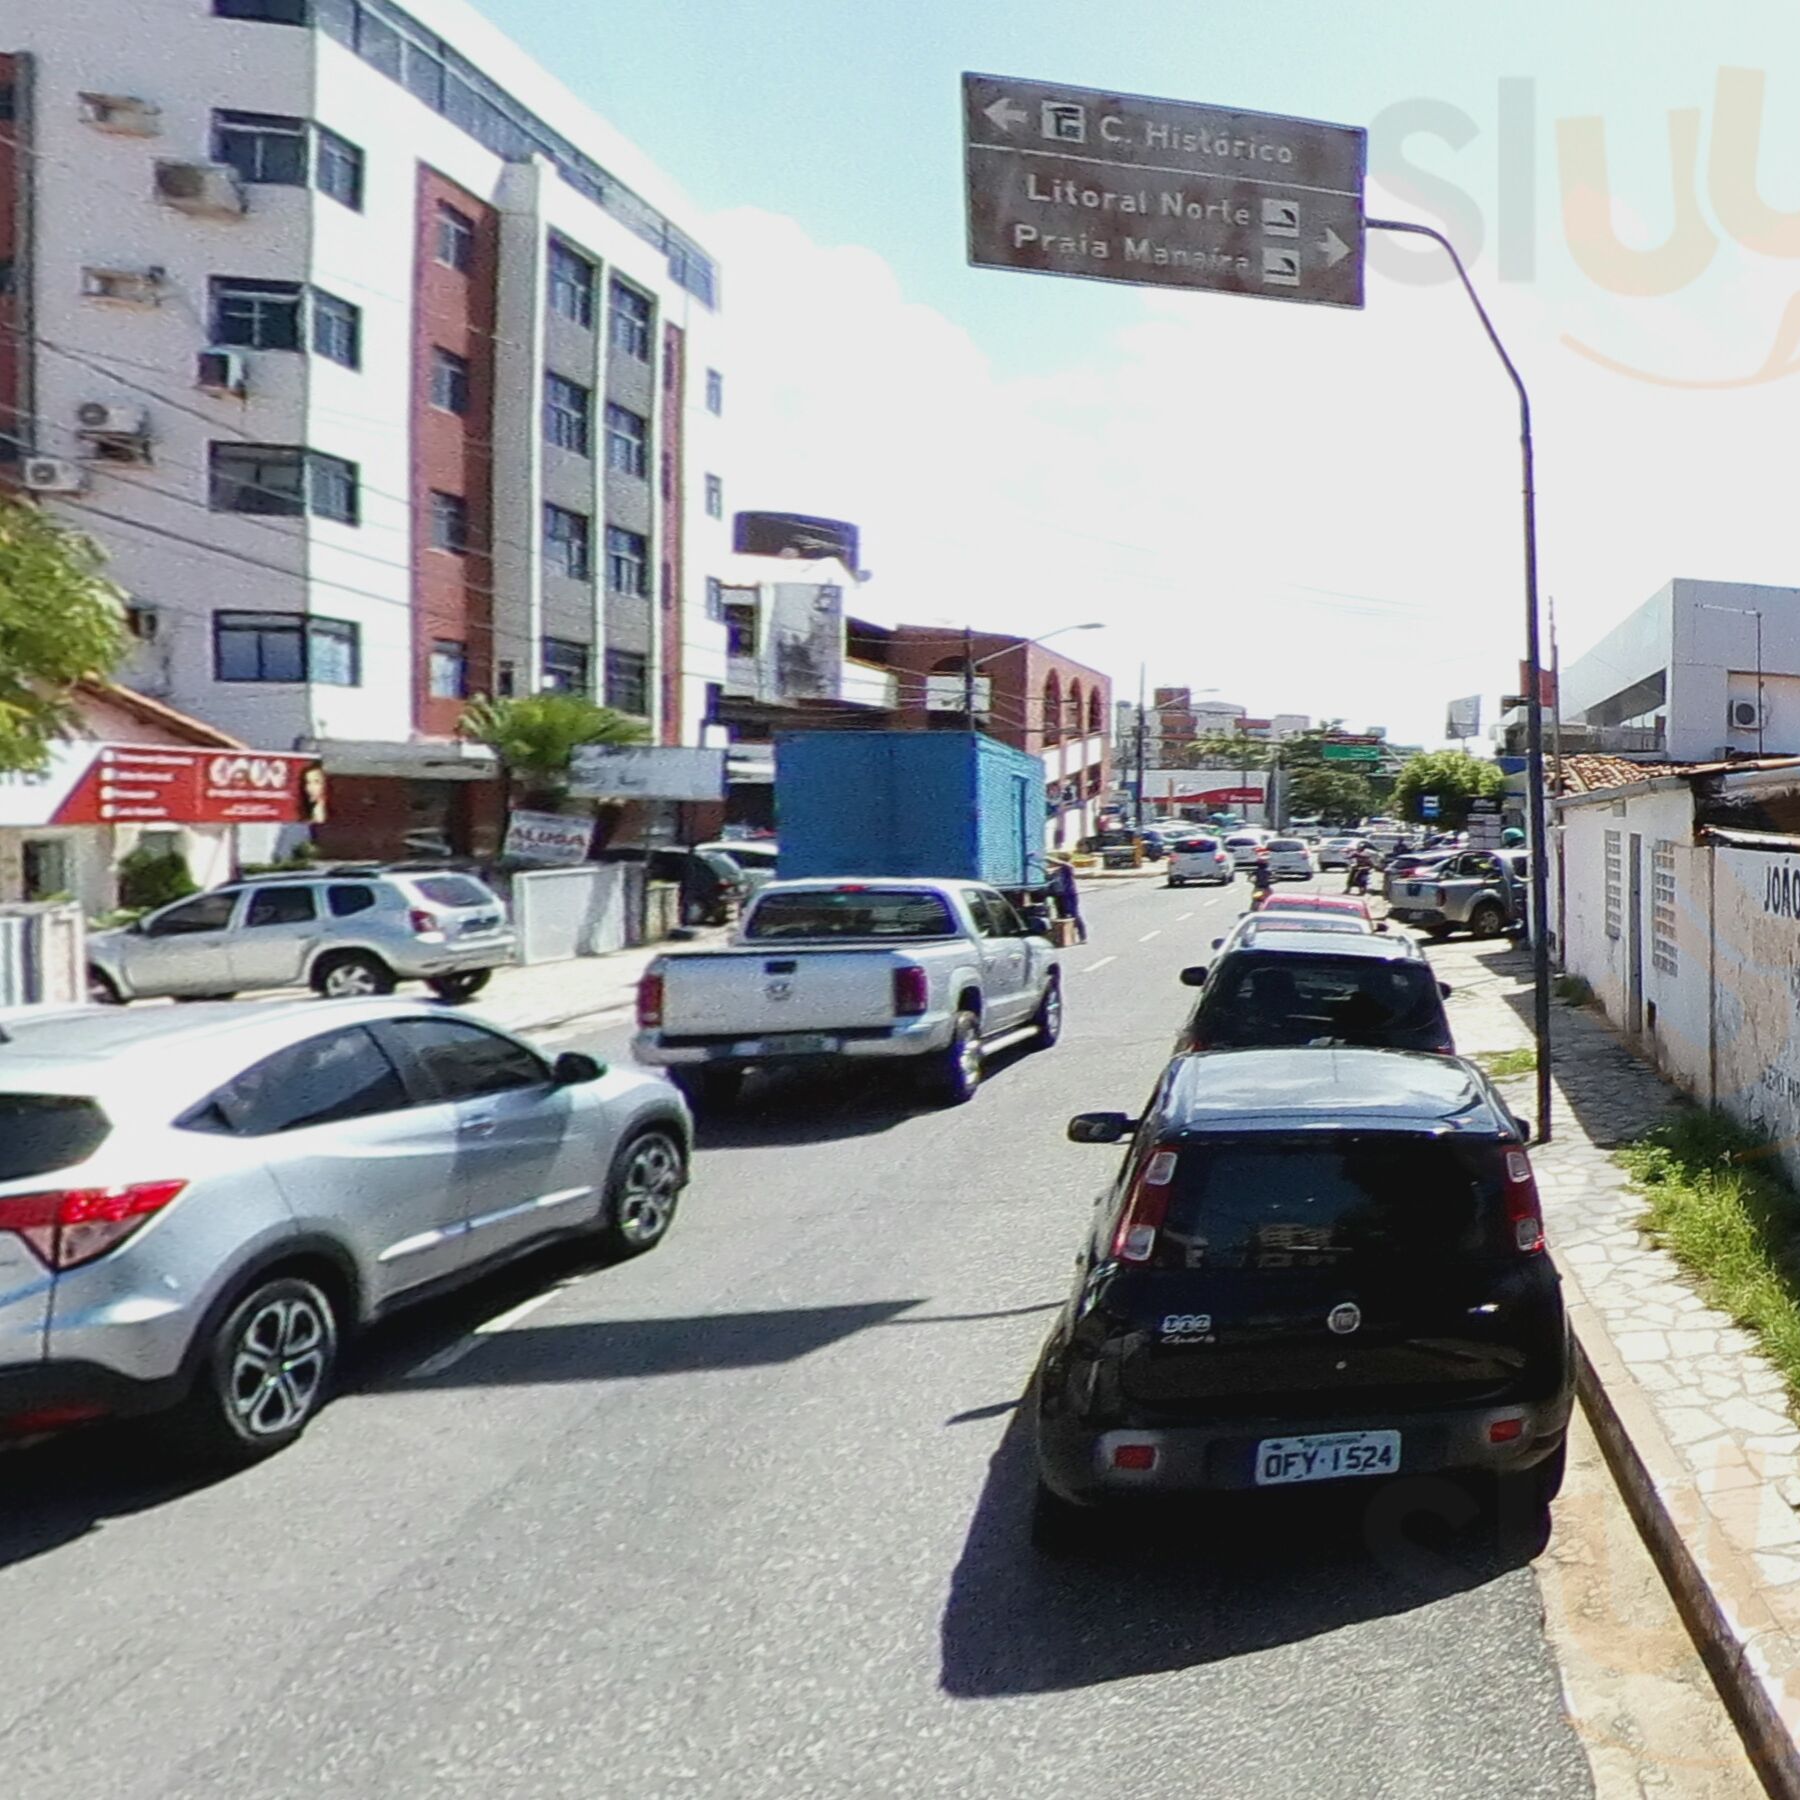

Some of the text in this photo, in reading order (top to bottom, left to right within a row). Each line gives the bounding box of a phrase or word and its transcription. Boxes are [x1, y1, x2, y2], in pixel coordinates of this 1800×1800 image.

[1100, 115, 1293, 164] C. Histórico
[1025, 173, 1250, 226] Litoral Norte
[1014, 223, 1110, 260] Praia
